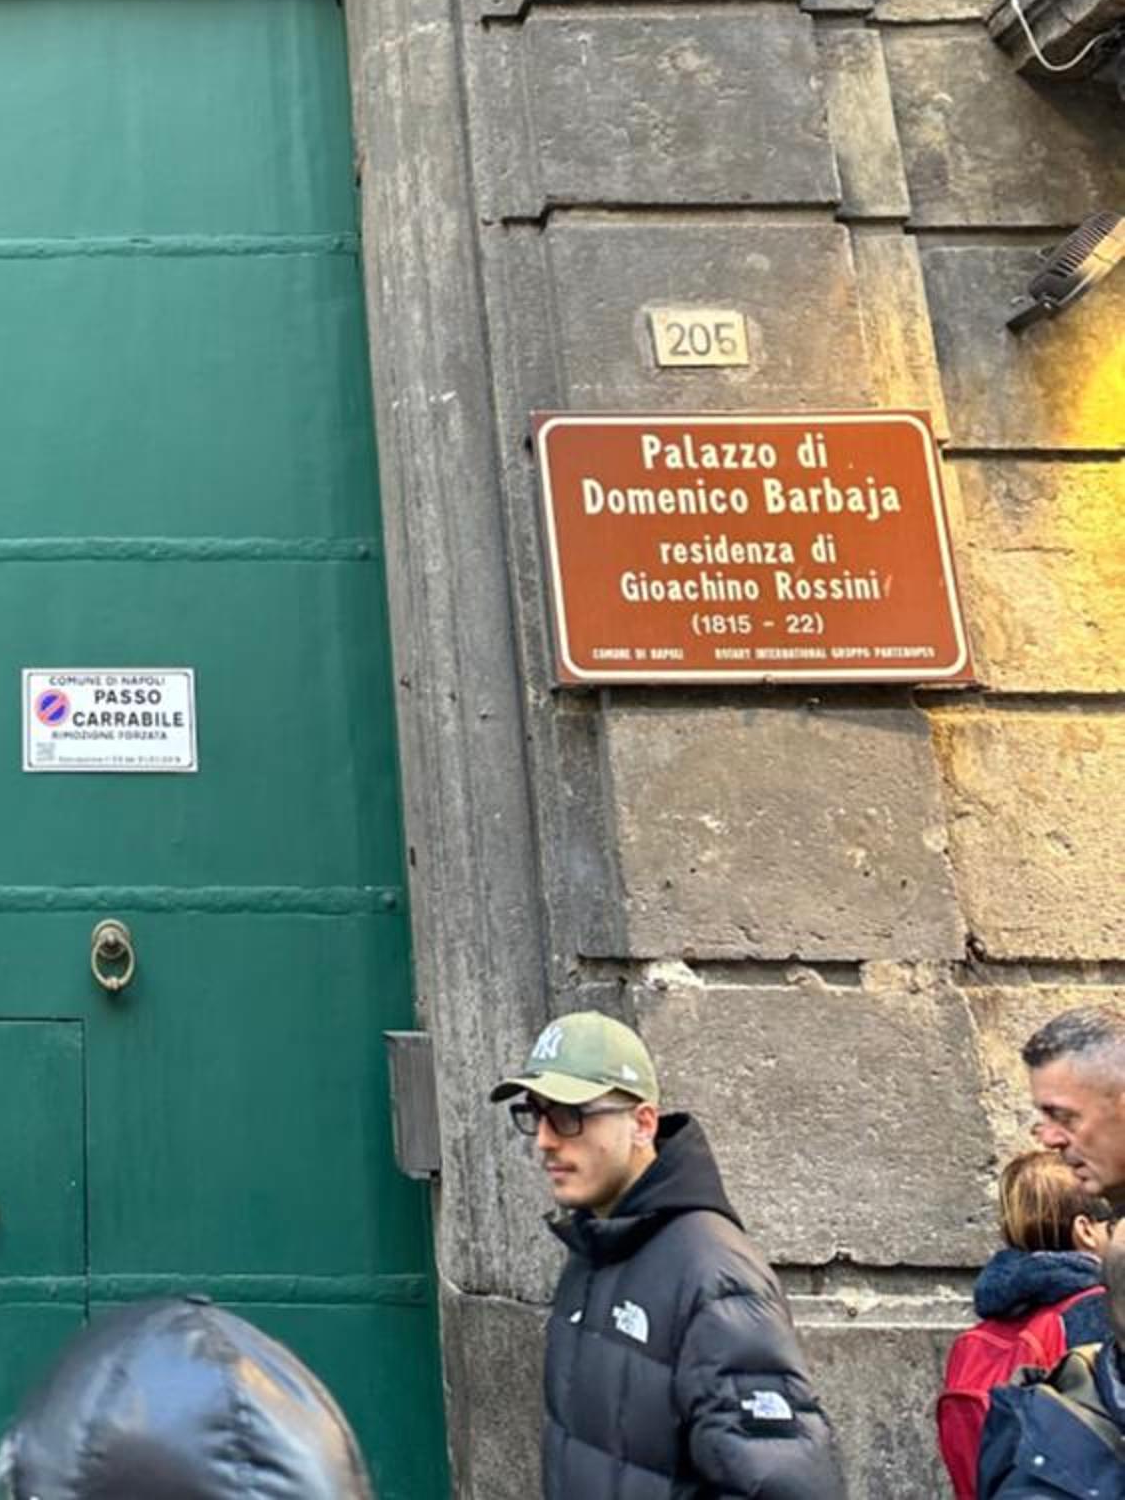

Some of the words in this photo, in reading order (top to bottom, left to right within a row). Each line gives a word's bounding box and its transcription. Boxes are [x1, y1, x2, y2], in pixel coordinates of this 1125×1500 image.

[665, 321, 738, 357] 205
[641, 434, 777, 469] Palazzo
[797, 433, 828, 468] di
[581, 478, 749, 515] Domenico
[763, 478, 901, 520] Barbaja
[659, 534, 795, 564] residenza
[811, 534, 837, 563] di
[620, 571, 760, 602] Gioachino
[775, 570, 881, 601] Rossini
[691, 613, 752, 635] (1815
[785, 613, 824, 634] 22)
[49, 676, 101, 686] COMUNE
[106, 676, 118, 686] DI
[121, 676, 166, 686] NAPOLI
[94, 688, 162, 705] PASSO
[72, 710, 184, 727] CARRABILE
[51, 731, 114, 740] RIMOZIONE
[117, 731, 167, 740] FORZATA
